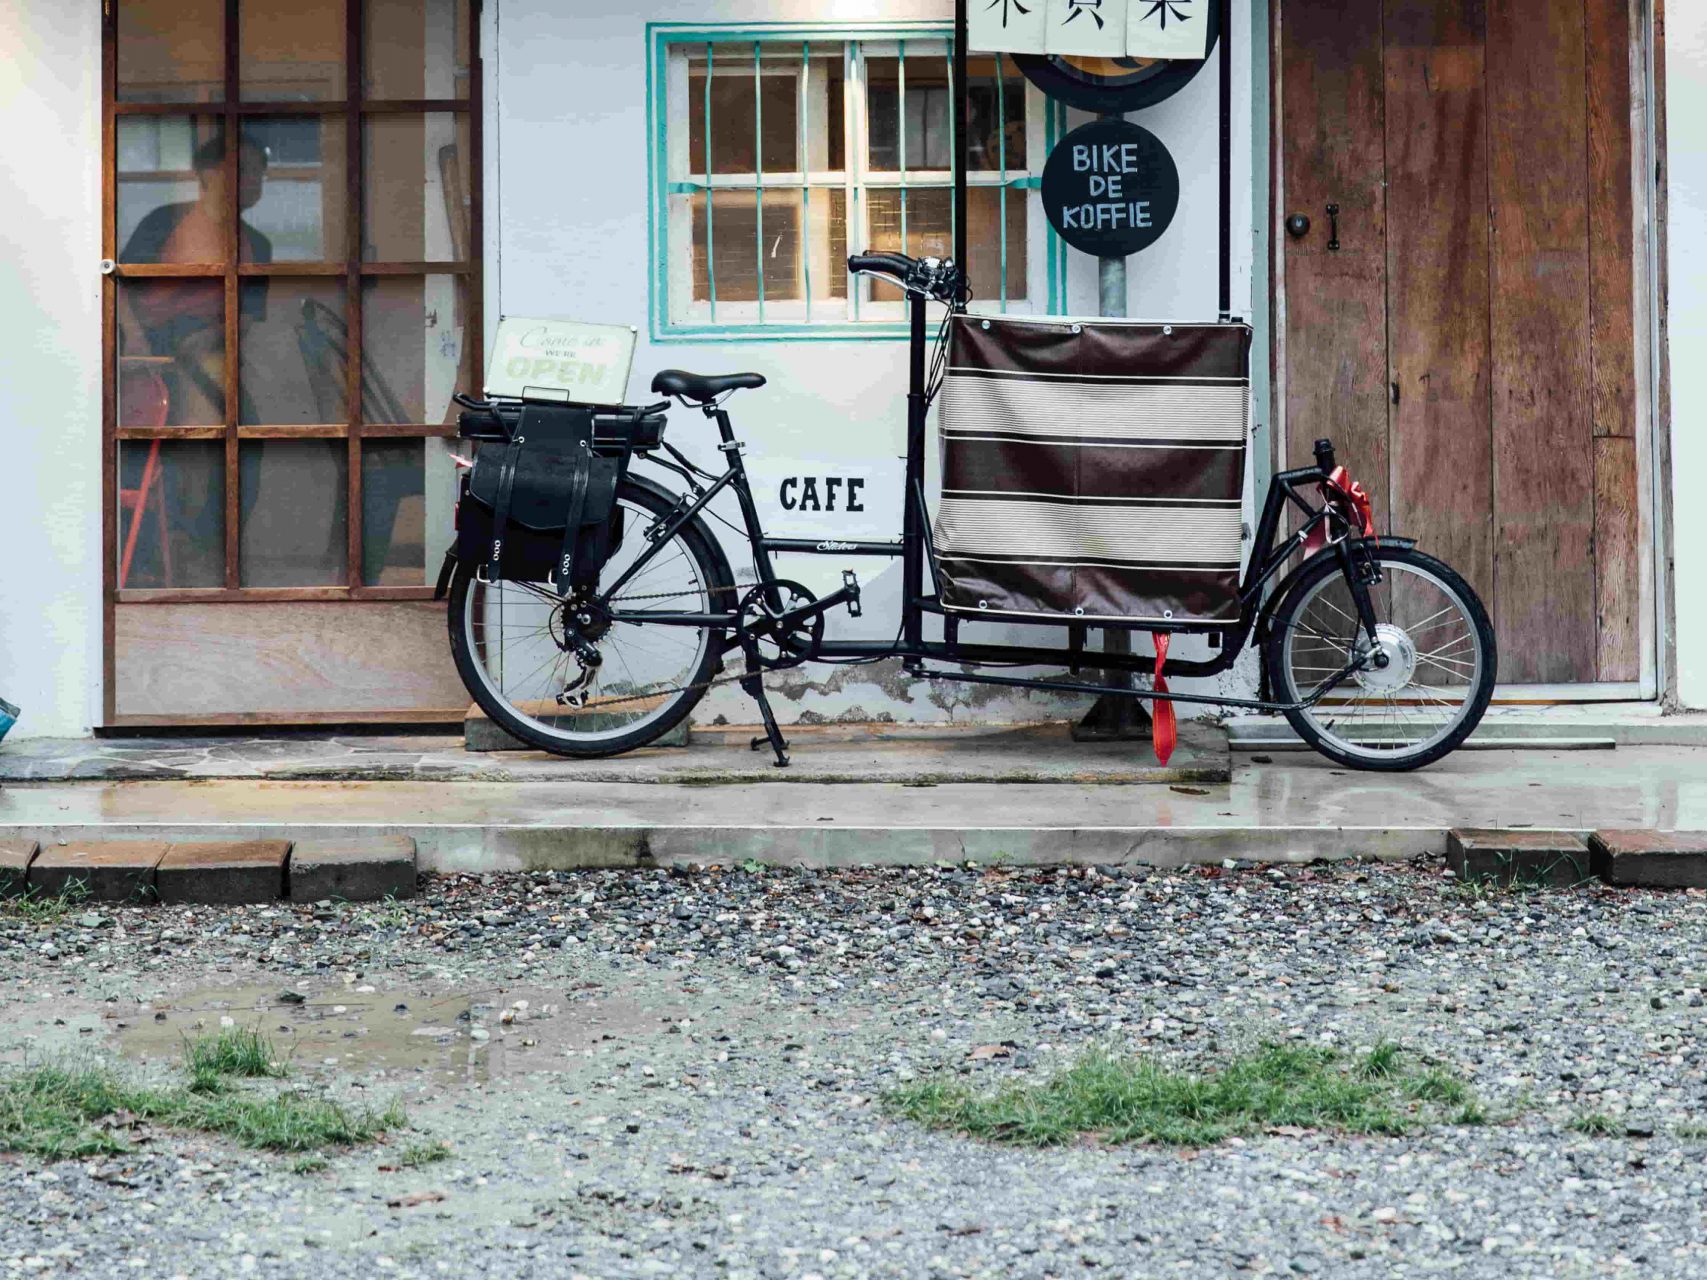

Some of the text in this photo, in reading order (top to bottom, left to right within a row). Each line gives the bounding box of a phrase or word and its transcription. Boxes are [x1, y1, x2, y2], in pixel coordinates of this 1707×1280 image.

[1072, 143, 1138, 174] BIKE
[1089, 175, 1122, 199] DE
[1062, 201, 1152, 229] KOFFIE
[520, 326, 578, 348] Come
[506, 357, 607, 385] OPEN
[779, 477, 864, 512] CAFE
